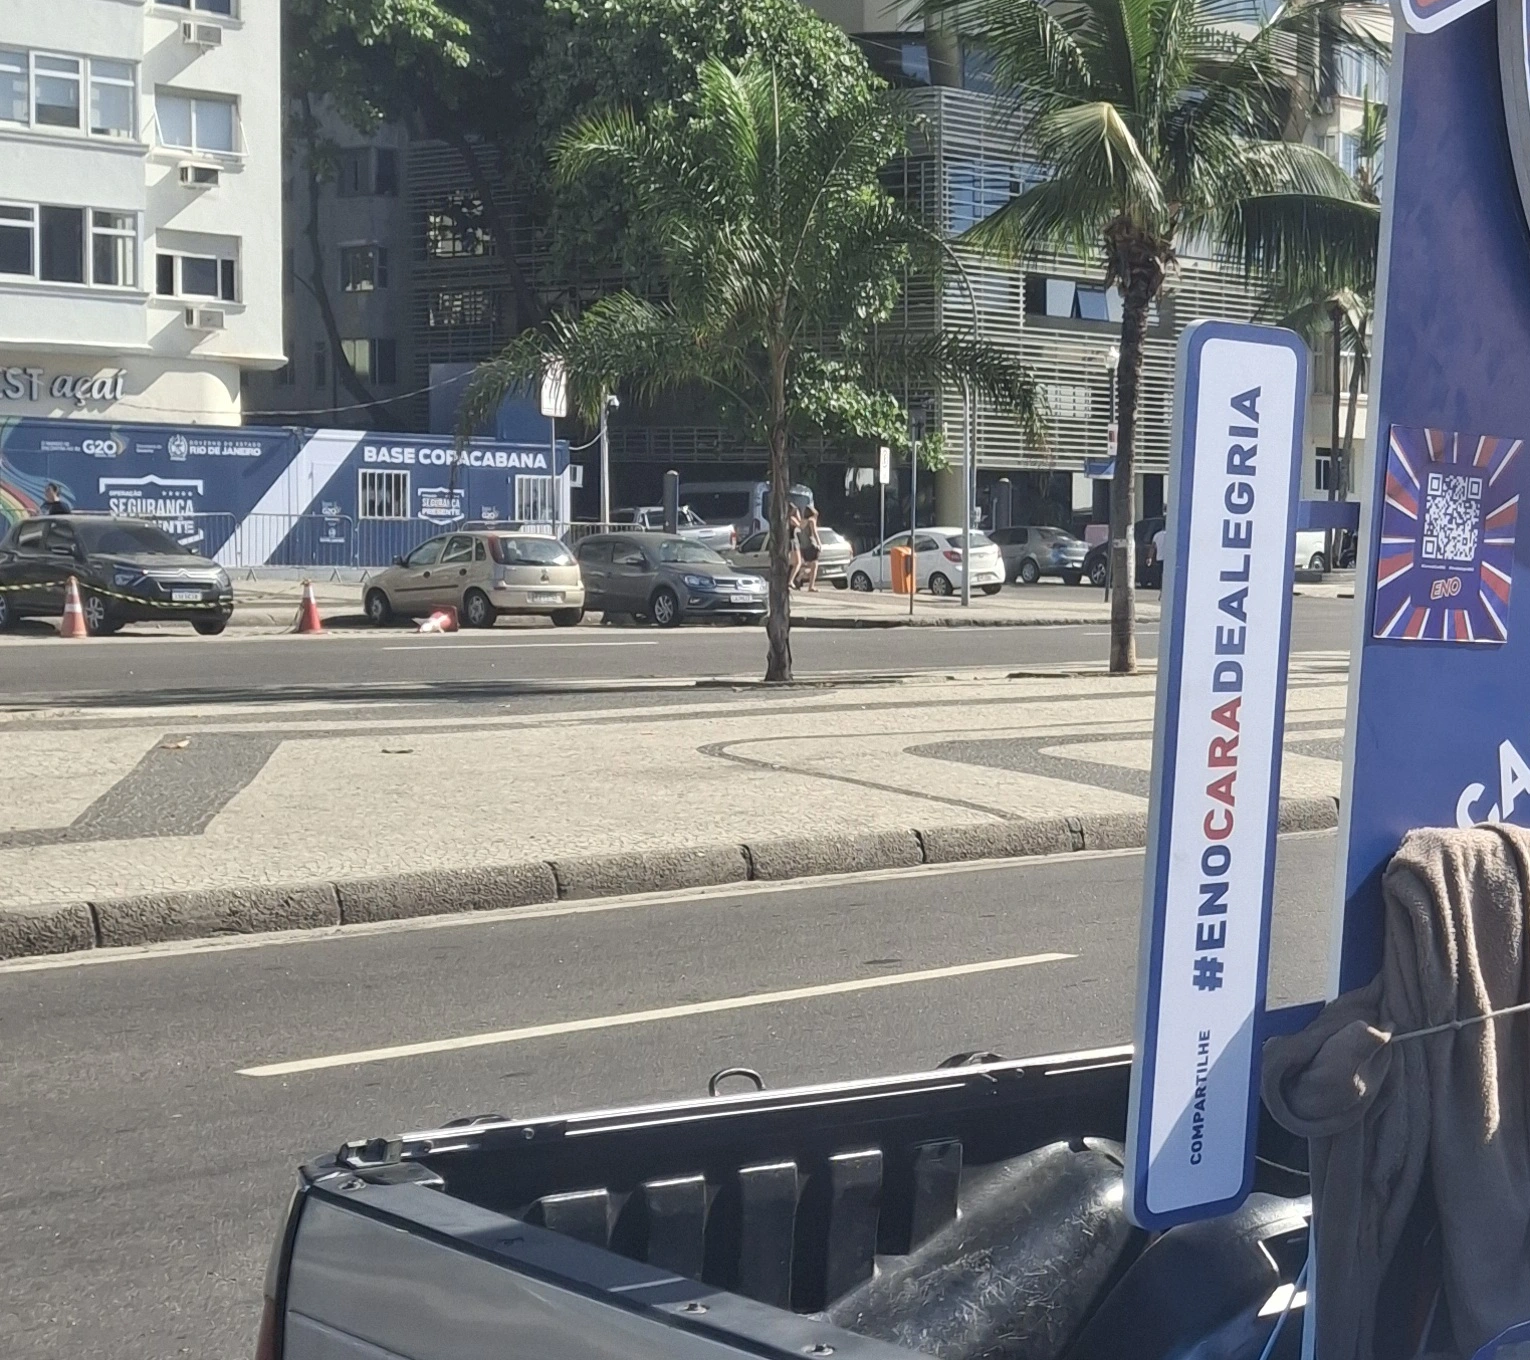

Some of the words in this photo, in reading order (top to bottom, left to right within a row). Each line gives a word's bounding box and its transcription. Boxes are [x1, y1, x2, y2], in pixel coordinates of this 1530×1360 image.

[0, 366, 44, 401] ST
[50, 367, 128, 407] açaí
[82, 439, 117, 455] G20
[189, 446, 207, 455] RIO
[208, 446, 221, 456] DE
[222, 447, 262, 457] JANEIRO
[363, 446, 416, 464] BASE
[418, 448, 548, 470] COPACABANA
[1430, 576, 1462, 600] ENO
[1192, 385, 1262, 992] #ENOCARADEALEGRIA
[1189, 1028, 1211, 1166] COMPARTILHE
